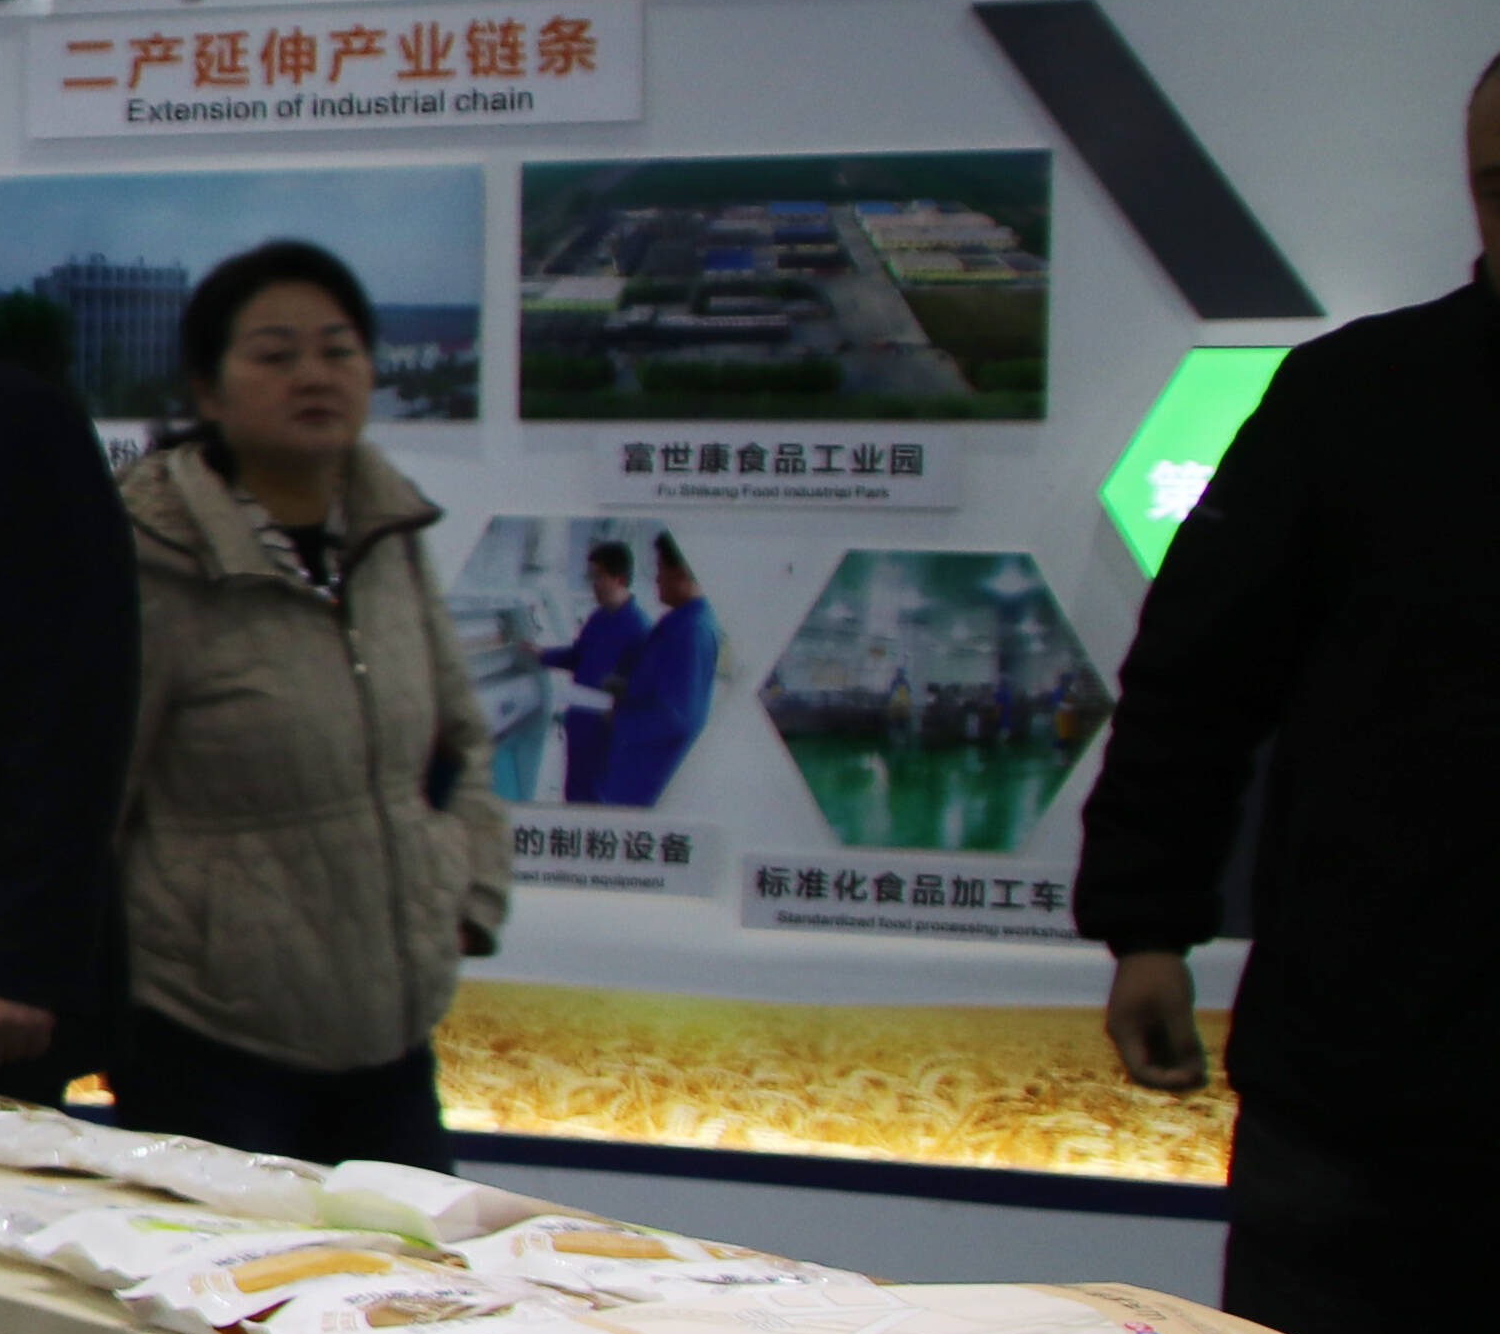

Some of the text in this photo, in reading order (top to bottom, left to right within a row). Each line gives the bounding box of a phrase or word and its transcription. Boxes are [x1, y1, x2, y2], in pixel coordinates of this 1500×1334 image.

[63, 14, 598, 90] 二产延伸产业链条
[126, 86, 534, 124] Extension of industrial chain
[623, 442, 925, 477] 富世康食品工业园
[513, 824, 694, 865] 的制粉设备
[756, 866, 1068, 913] 标准化食品加工车
